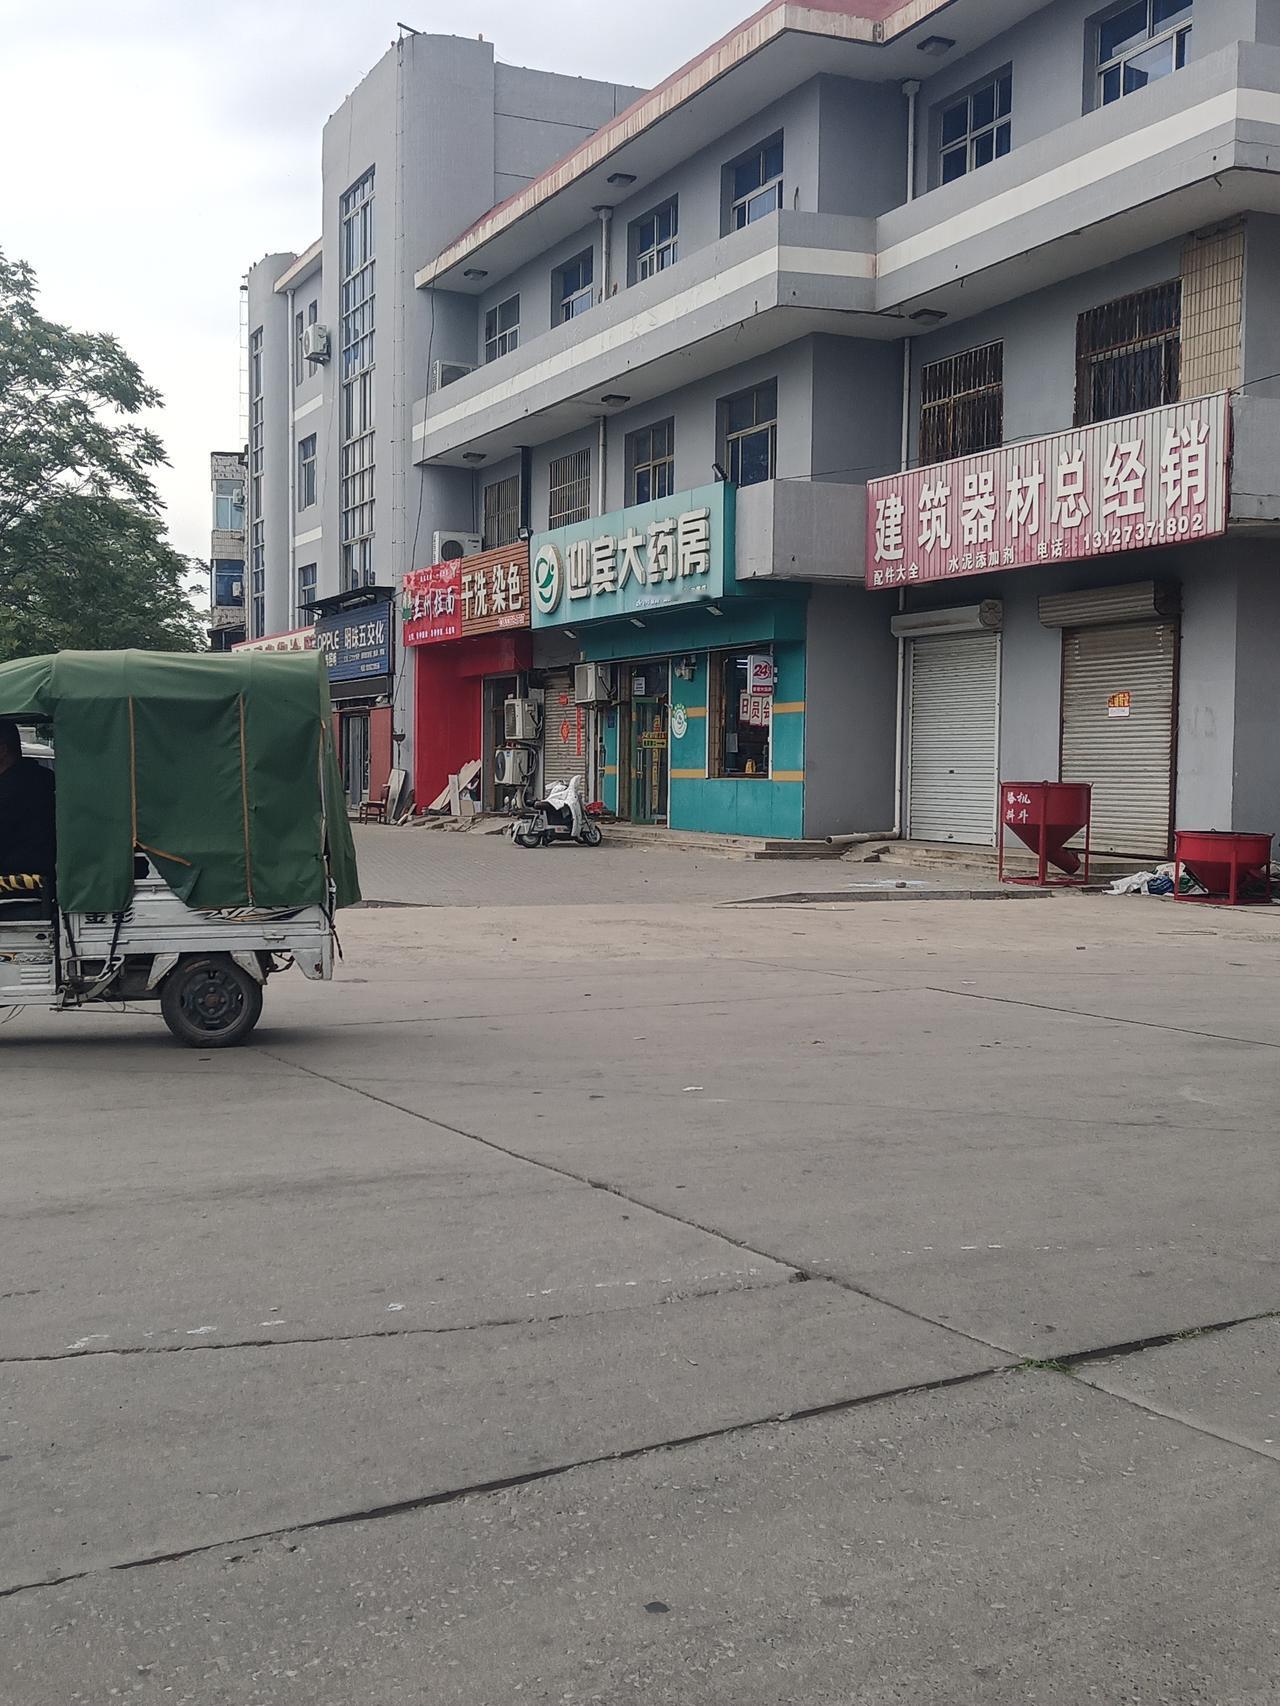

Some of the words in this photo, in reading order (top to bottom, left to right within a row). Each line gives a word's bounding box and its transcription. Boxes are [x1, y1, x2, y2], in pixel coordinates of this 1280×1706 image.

[874, 418, 1210, 563] 建筑器材总经销
[1084, 513, 1204, 550] 13127371802
[566, 507, 711, 600] 迎宾大药房
[948, 546, 1014, 573] 水泥添加剂
[873, 563, 919, 586] 配件大全
